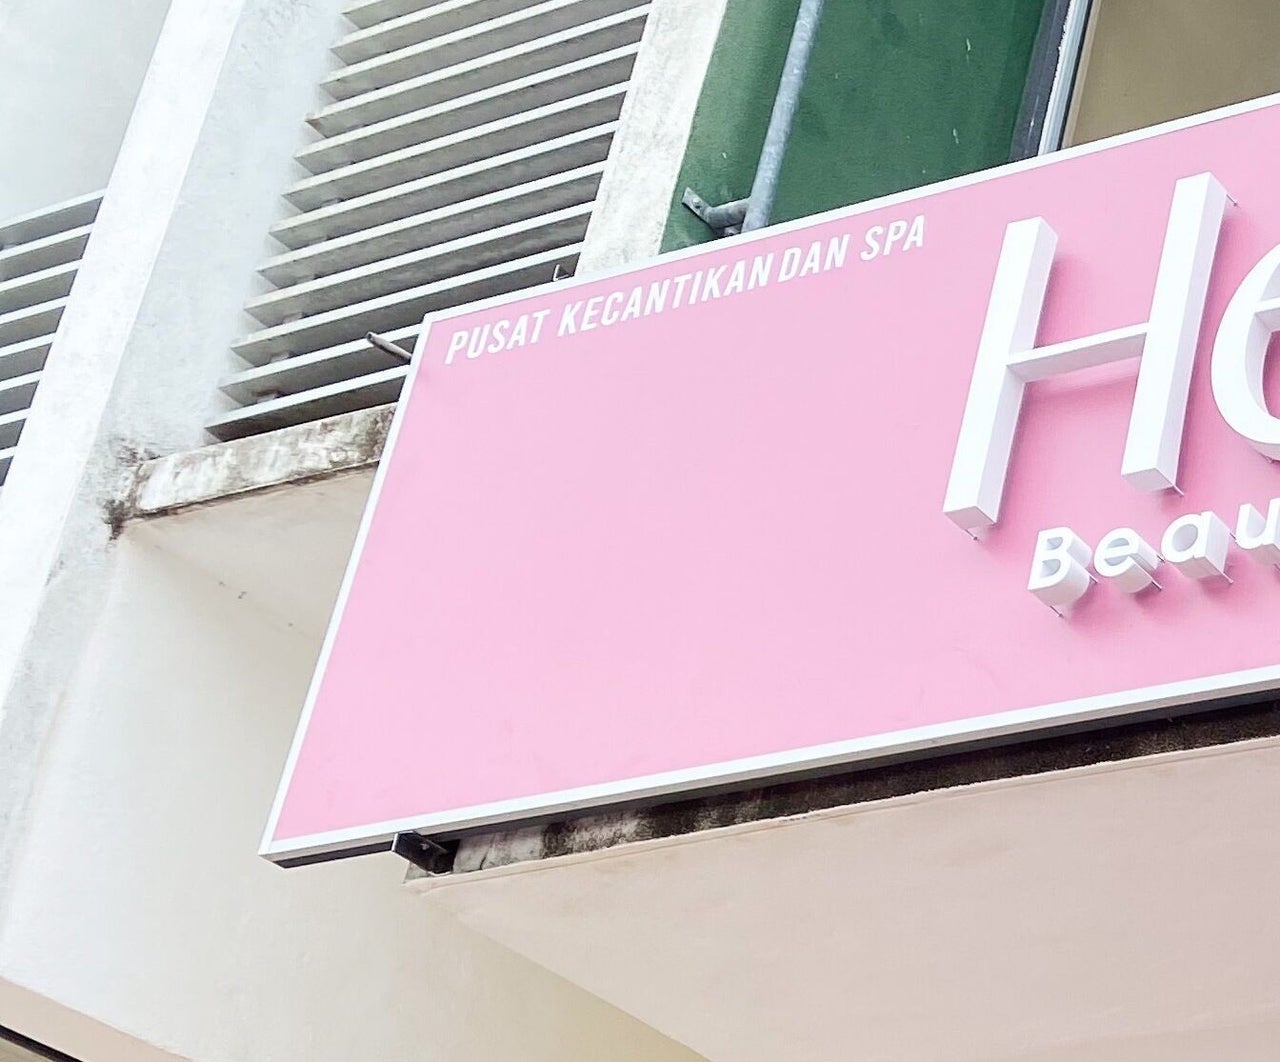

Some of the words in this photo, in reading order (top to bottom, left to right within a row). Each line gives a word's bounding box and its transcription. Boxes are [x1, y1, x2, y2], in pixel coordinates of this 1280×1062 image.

[445, 309, 550, 365] PUSAT
[557, 259, 774, 337] KECANTIKAN
[777, 234, 850, 283] DAN
[859, 215, 926, 262] SPA
